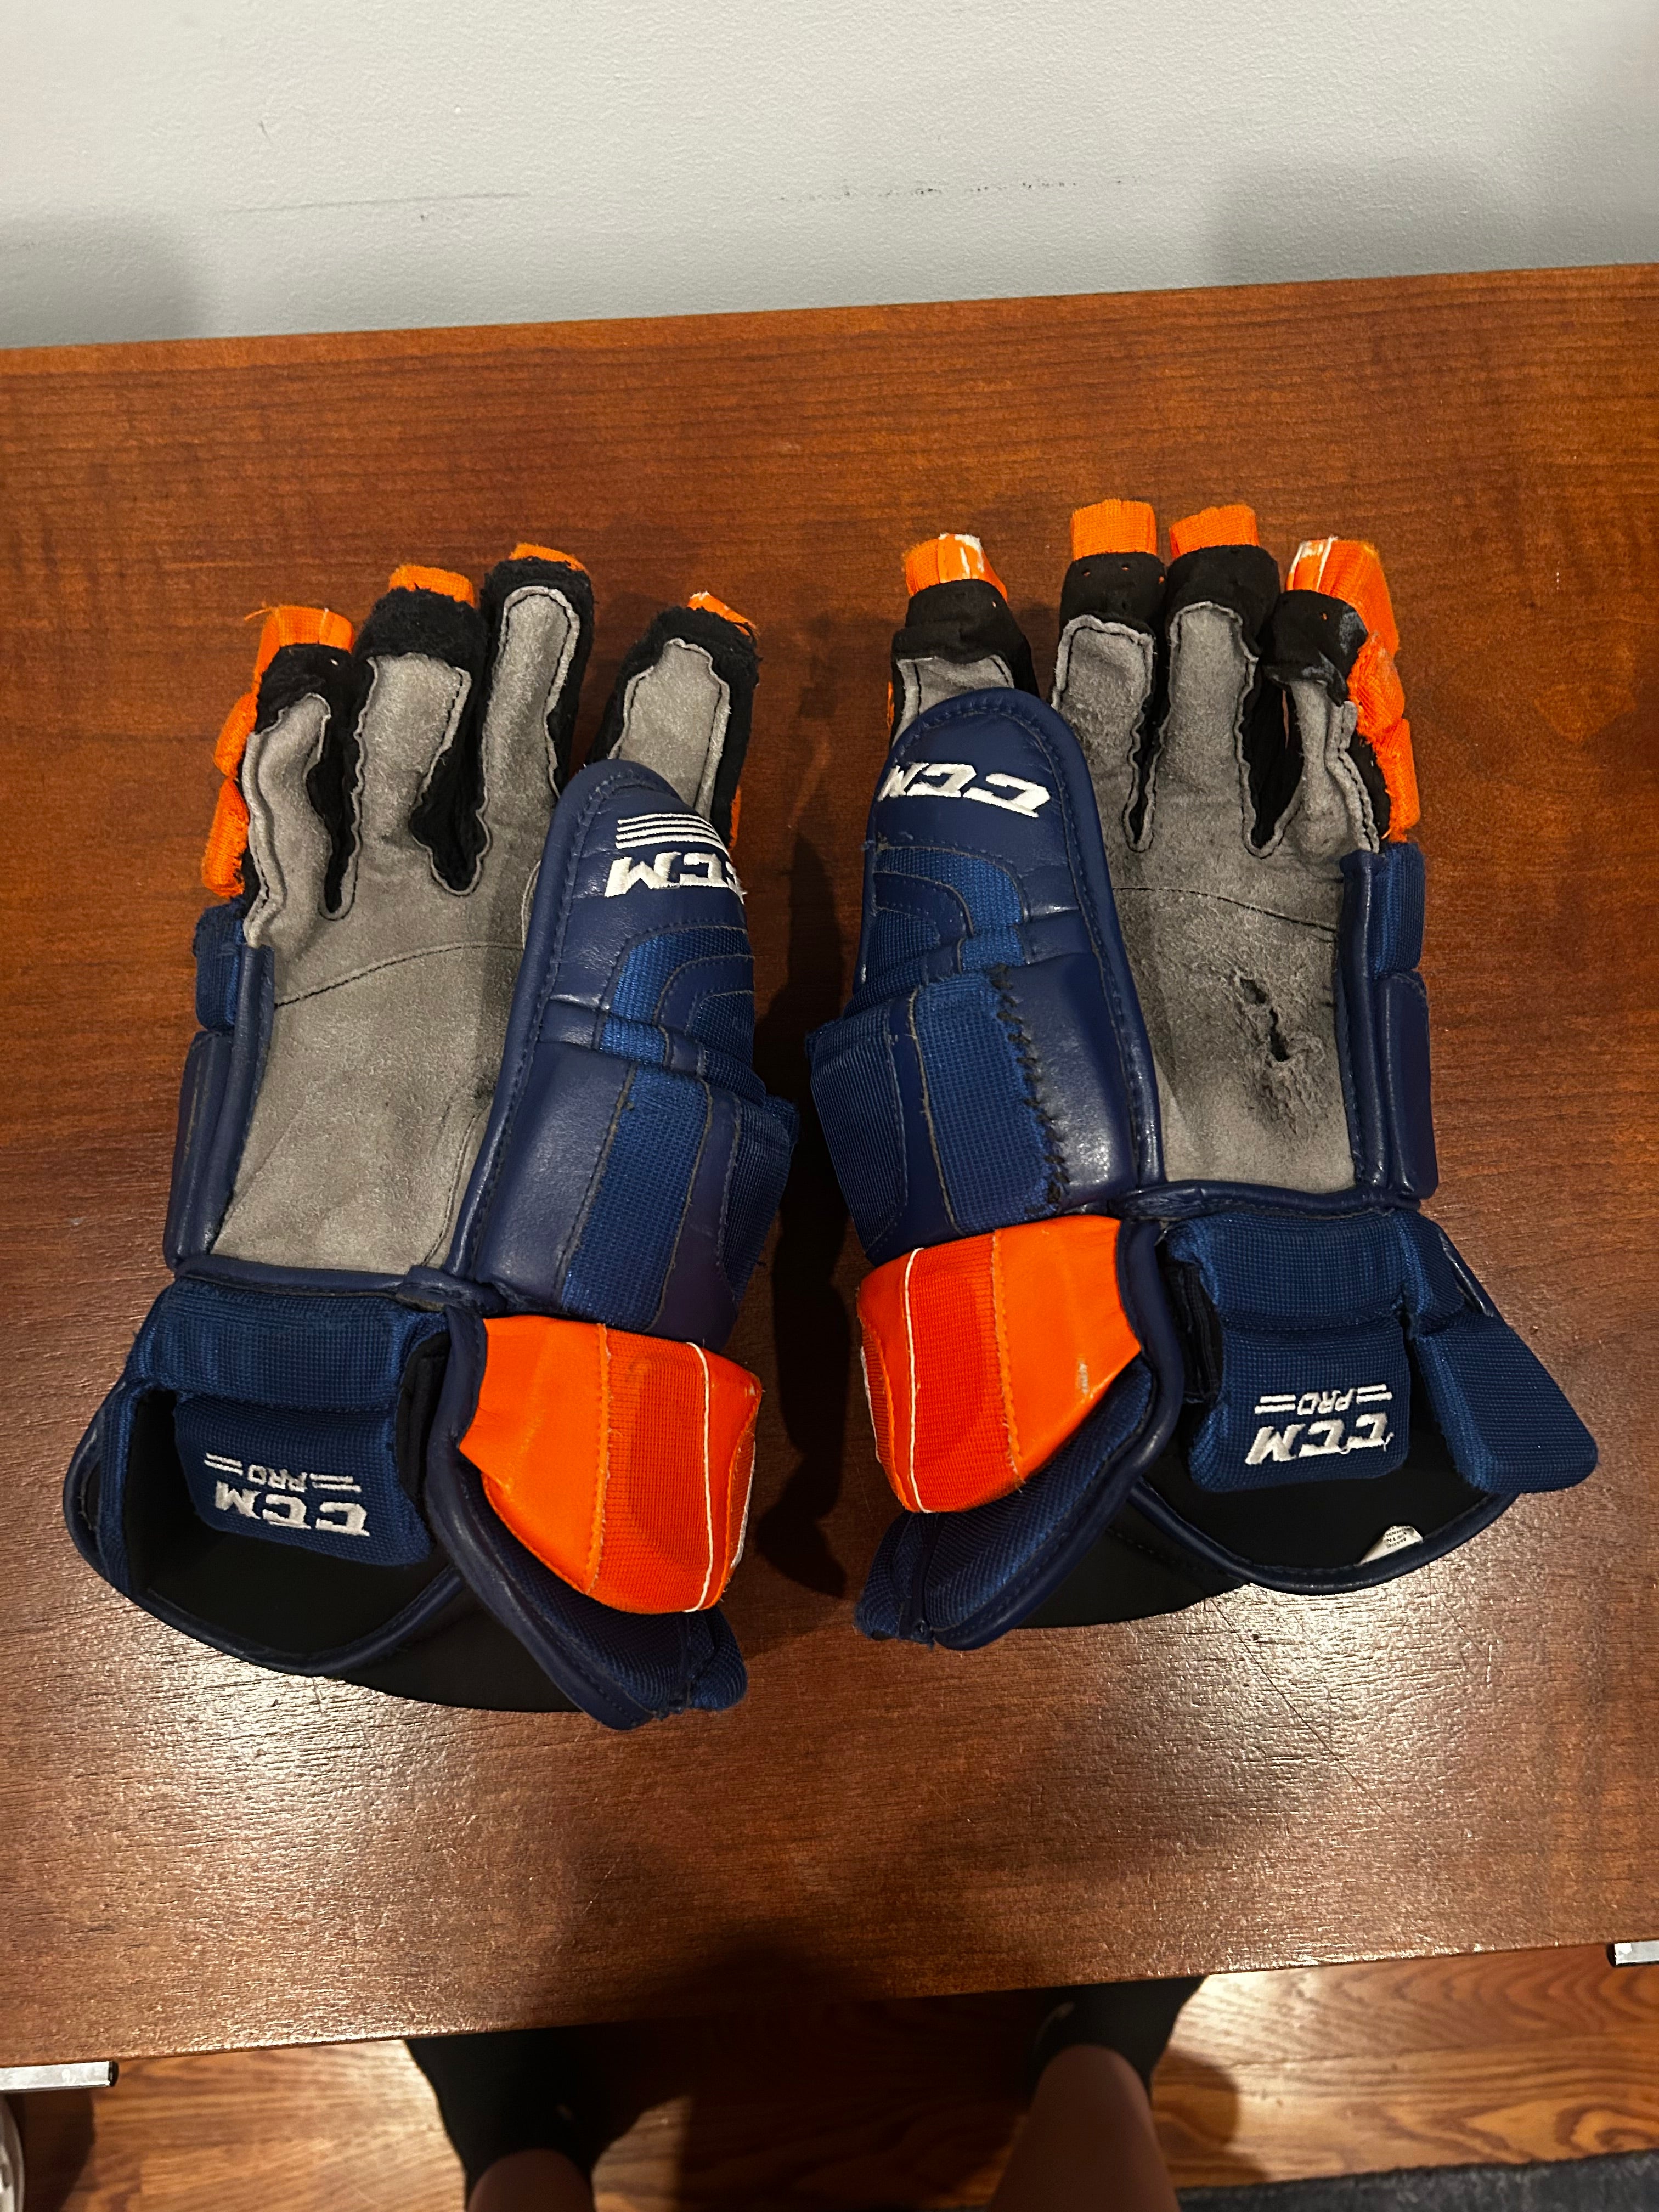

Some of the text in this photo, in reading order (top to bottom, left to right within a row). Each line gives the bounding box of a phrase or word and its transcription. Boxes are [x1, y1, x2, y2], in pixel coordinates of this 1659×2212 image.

[878, 763, 1051, 819] CCM
[1297, 1389, 1357, 1415] PRO
[1244, 1412, 1391, 1465] CCM
[247, 1464, 308, 1493] PRO
[215, 1481, 370, 1536] CCM
